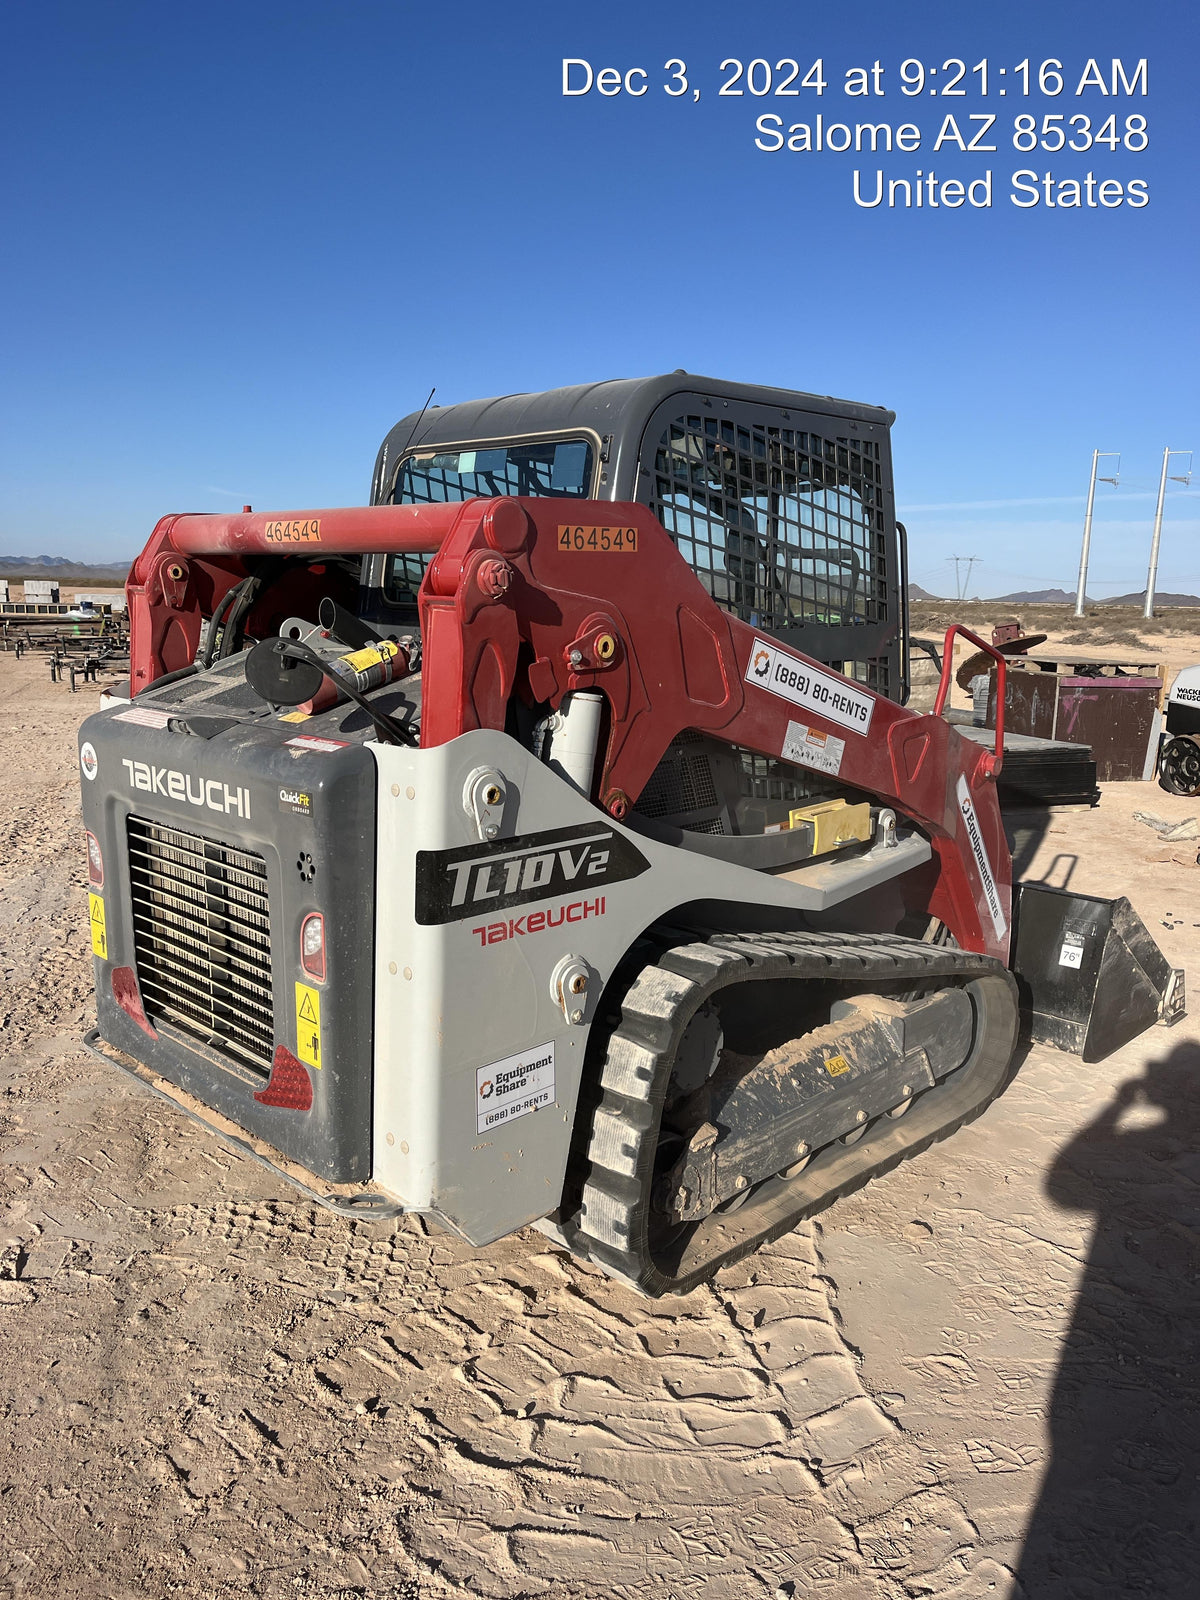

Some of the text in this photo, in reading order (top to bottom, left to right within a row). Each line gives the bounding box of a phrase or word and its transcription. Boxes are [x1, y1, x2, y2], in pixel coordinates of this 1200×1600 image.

[266, 520, 320, 541] 464549
[560, 526, 637, 551] 464549
[774, 663, 869, 722] (888) 80-RENTS
[122, 758, 251, 820] TAKEUCHI
[280, 789, 310, 807] QuickFit
[966, 811, 1000, 919] EquipmentShare
[472, 896, 606, 947] TAKEUCHI
[495, 1054, 553, 1086] Equipment
[495, 1077, 527, 1097] Share
[485, 1092, 549, 1126] (888) 80-RENTS
